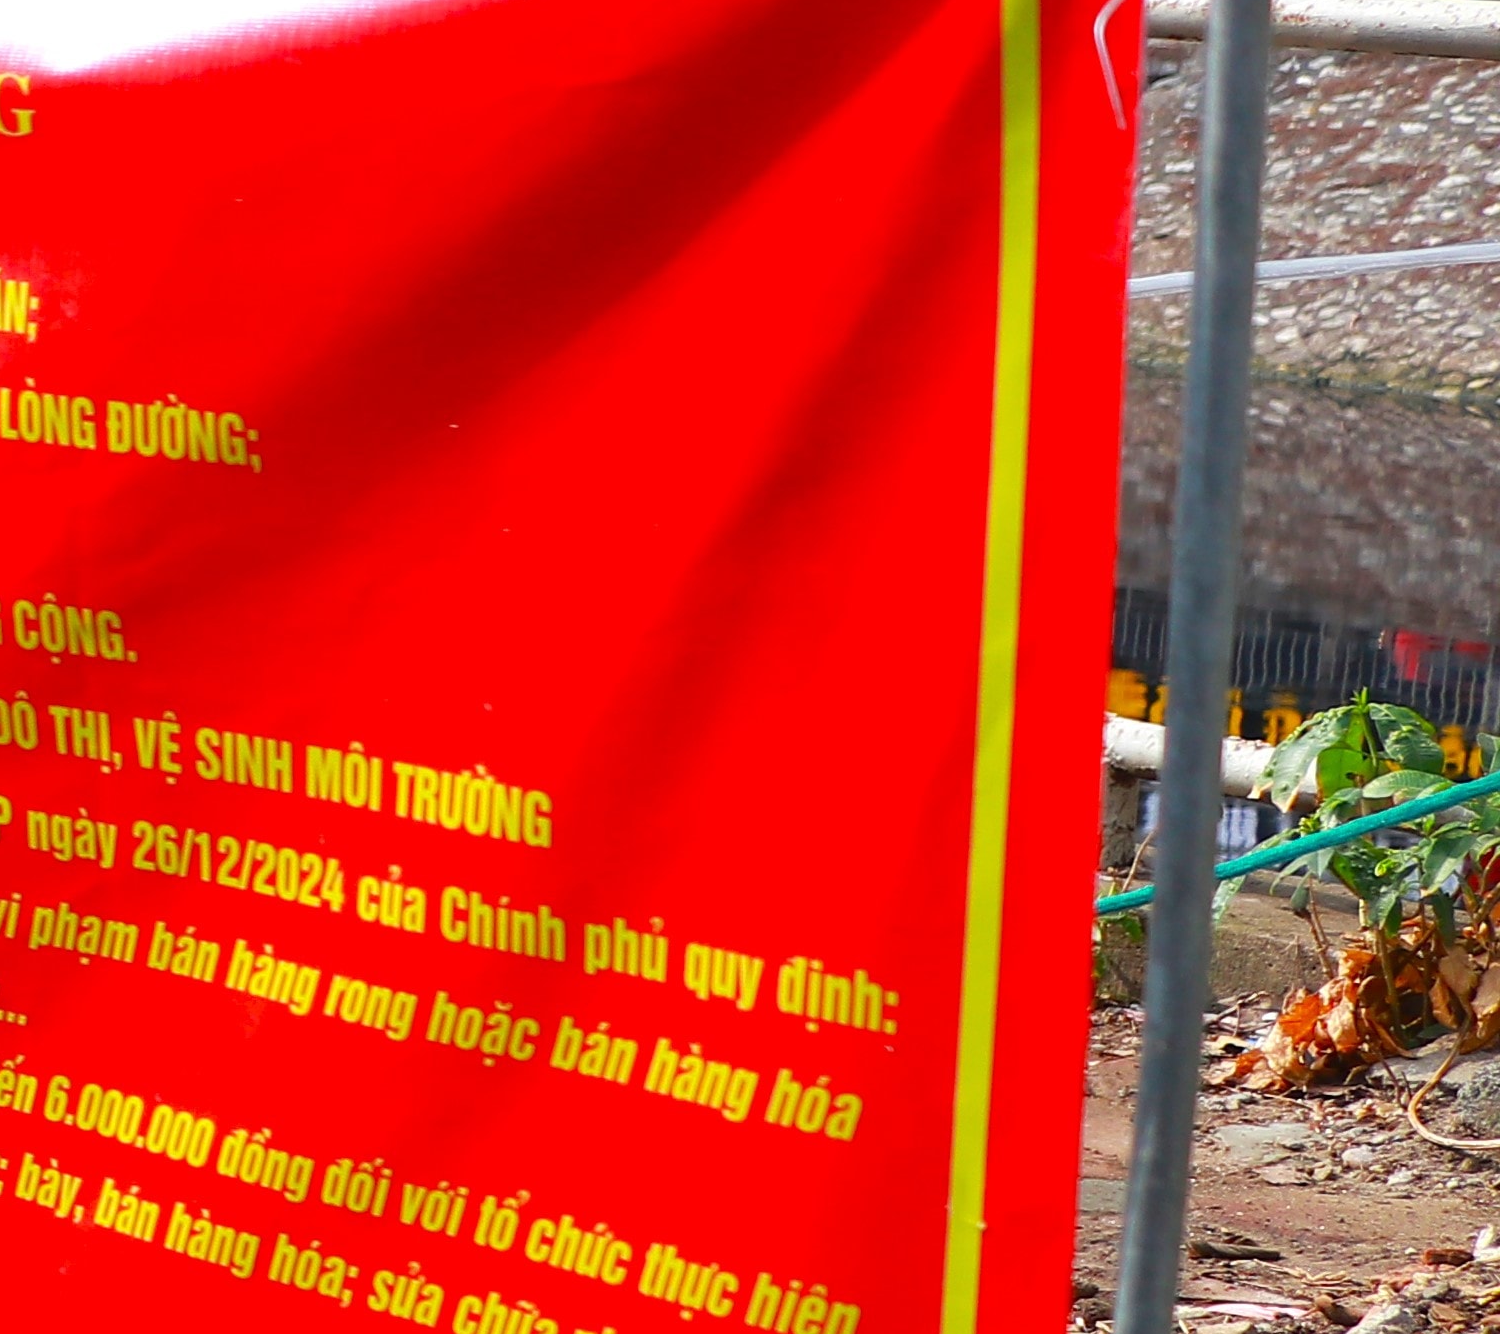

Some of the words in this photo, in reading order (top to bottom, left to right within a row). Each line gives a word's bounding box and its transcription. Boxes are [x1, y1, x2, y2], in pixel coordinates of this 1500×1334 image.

[105, 392, 259, 468] ĐƯỜNG;
[12, 590, 136, 663] CỘNG.
[48, 704, 122, 774] THỊ,
[133, 709, 182, 784] VỆ
[194, 725, 292, 793] SINH
[305, 739, 383, 812] MÔI
[391, 759, 551, 848] TRƯỜNG
[43, 1073, 216, 1168] 6.000.000
[215, 1126, 314, 1203] đồng
[320, 1156, 392, 1217] đối
[399, 1179, 469, 1237] với
[473, 1188, 530, 1251] tổ
[524, 1212, 632, 1285] chức
[637, 1241, 739, 1321] thực
